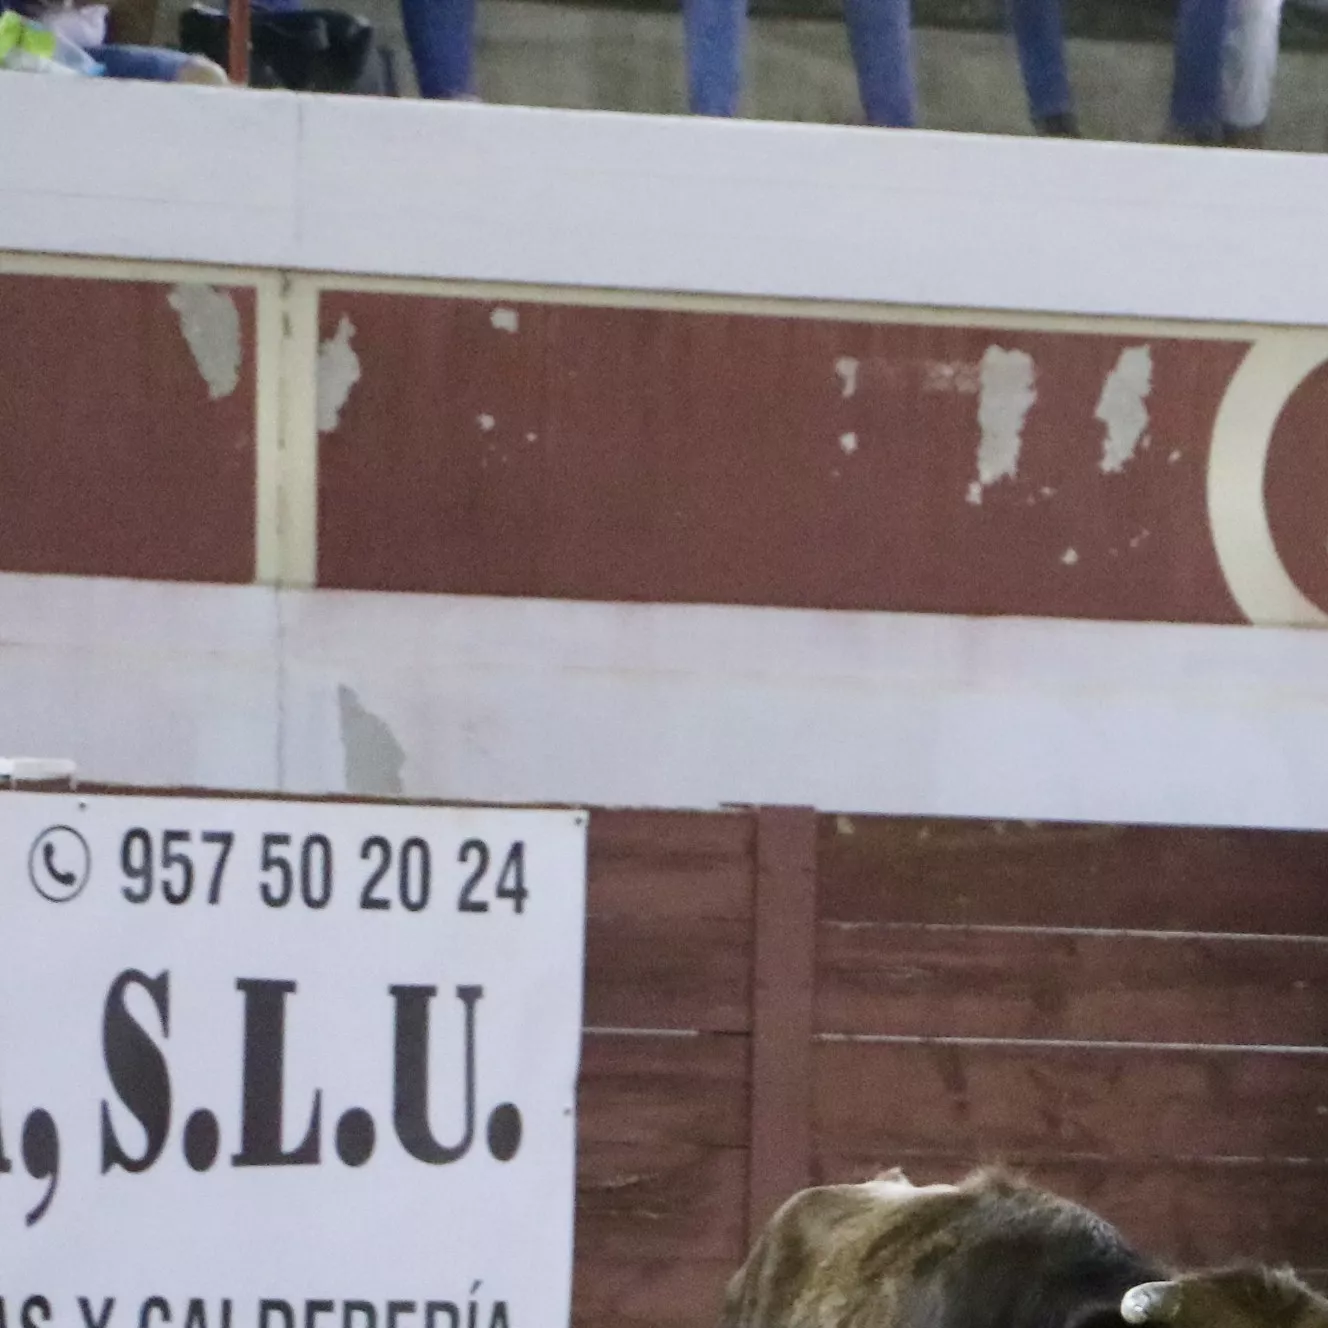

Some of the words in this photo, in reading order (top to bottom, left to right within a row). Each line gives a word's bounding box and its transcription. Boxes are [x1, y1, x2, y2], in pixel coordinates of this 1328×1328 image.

[120, 827, 235, 906] 957
[259, 832, 333, 910] 50
[359, 835, 432, 912] 20
[457, 838, 529, 914] 24
[100, 968, 523, 1175] S.L.U.
